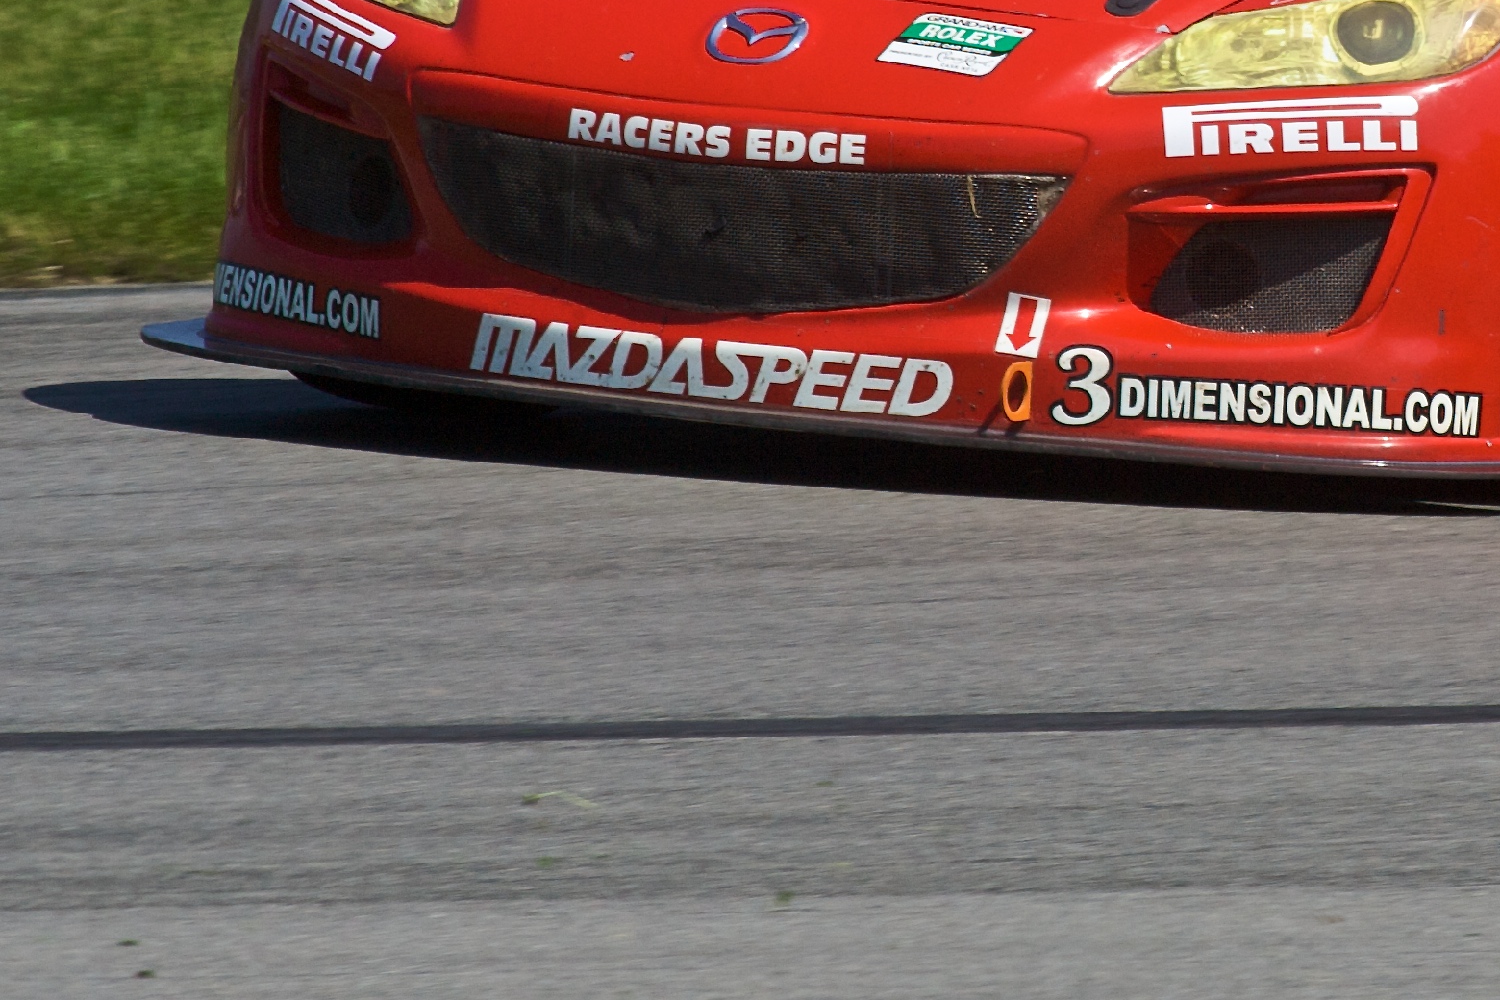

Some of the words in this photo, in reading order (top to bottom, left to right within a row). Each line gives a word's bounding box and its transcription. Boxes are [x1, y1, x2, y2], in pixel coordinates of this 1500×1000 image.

[919, 24, 1004, 48] ROLEX
[567, 108, 732, 159] RACERS
[744, 128, 868, 166] EDGE
[1162, 95, 1419, 158] PIRELLI
[469, 312, 954, 417] MAZDASPEED
